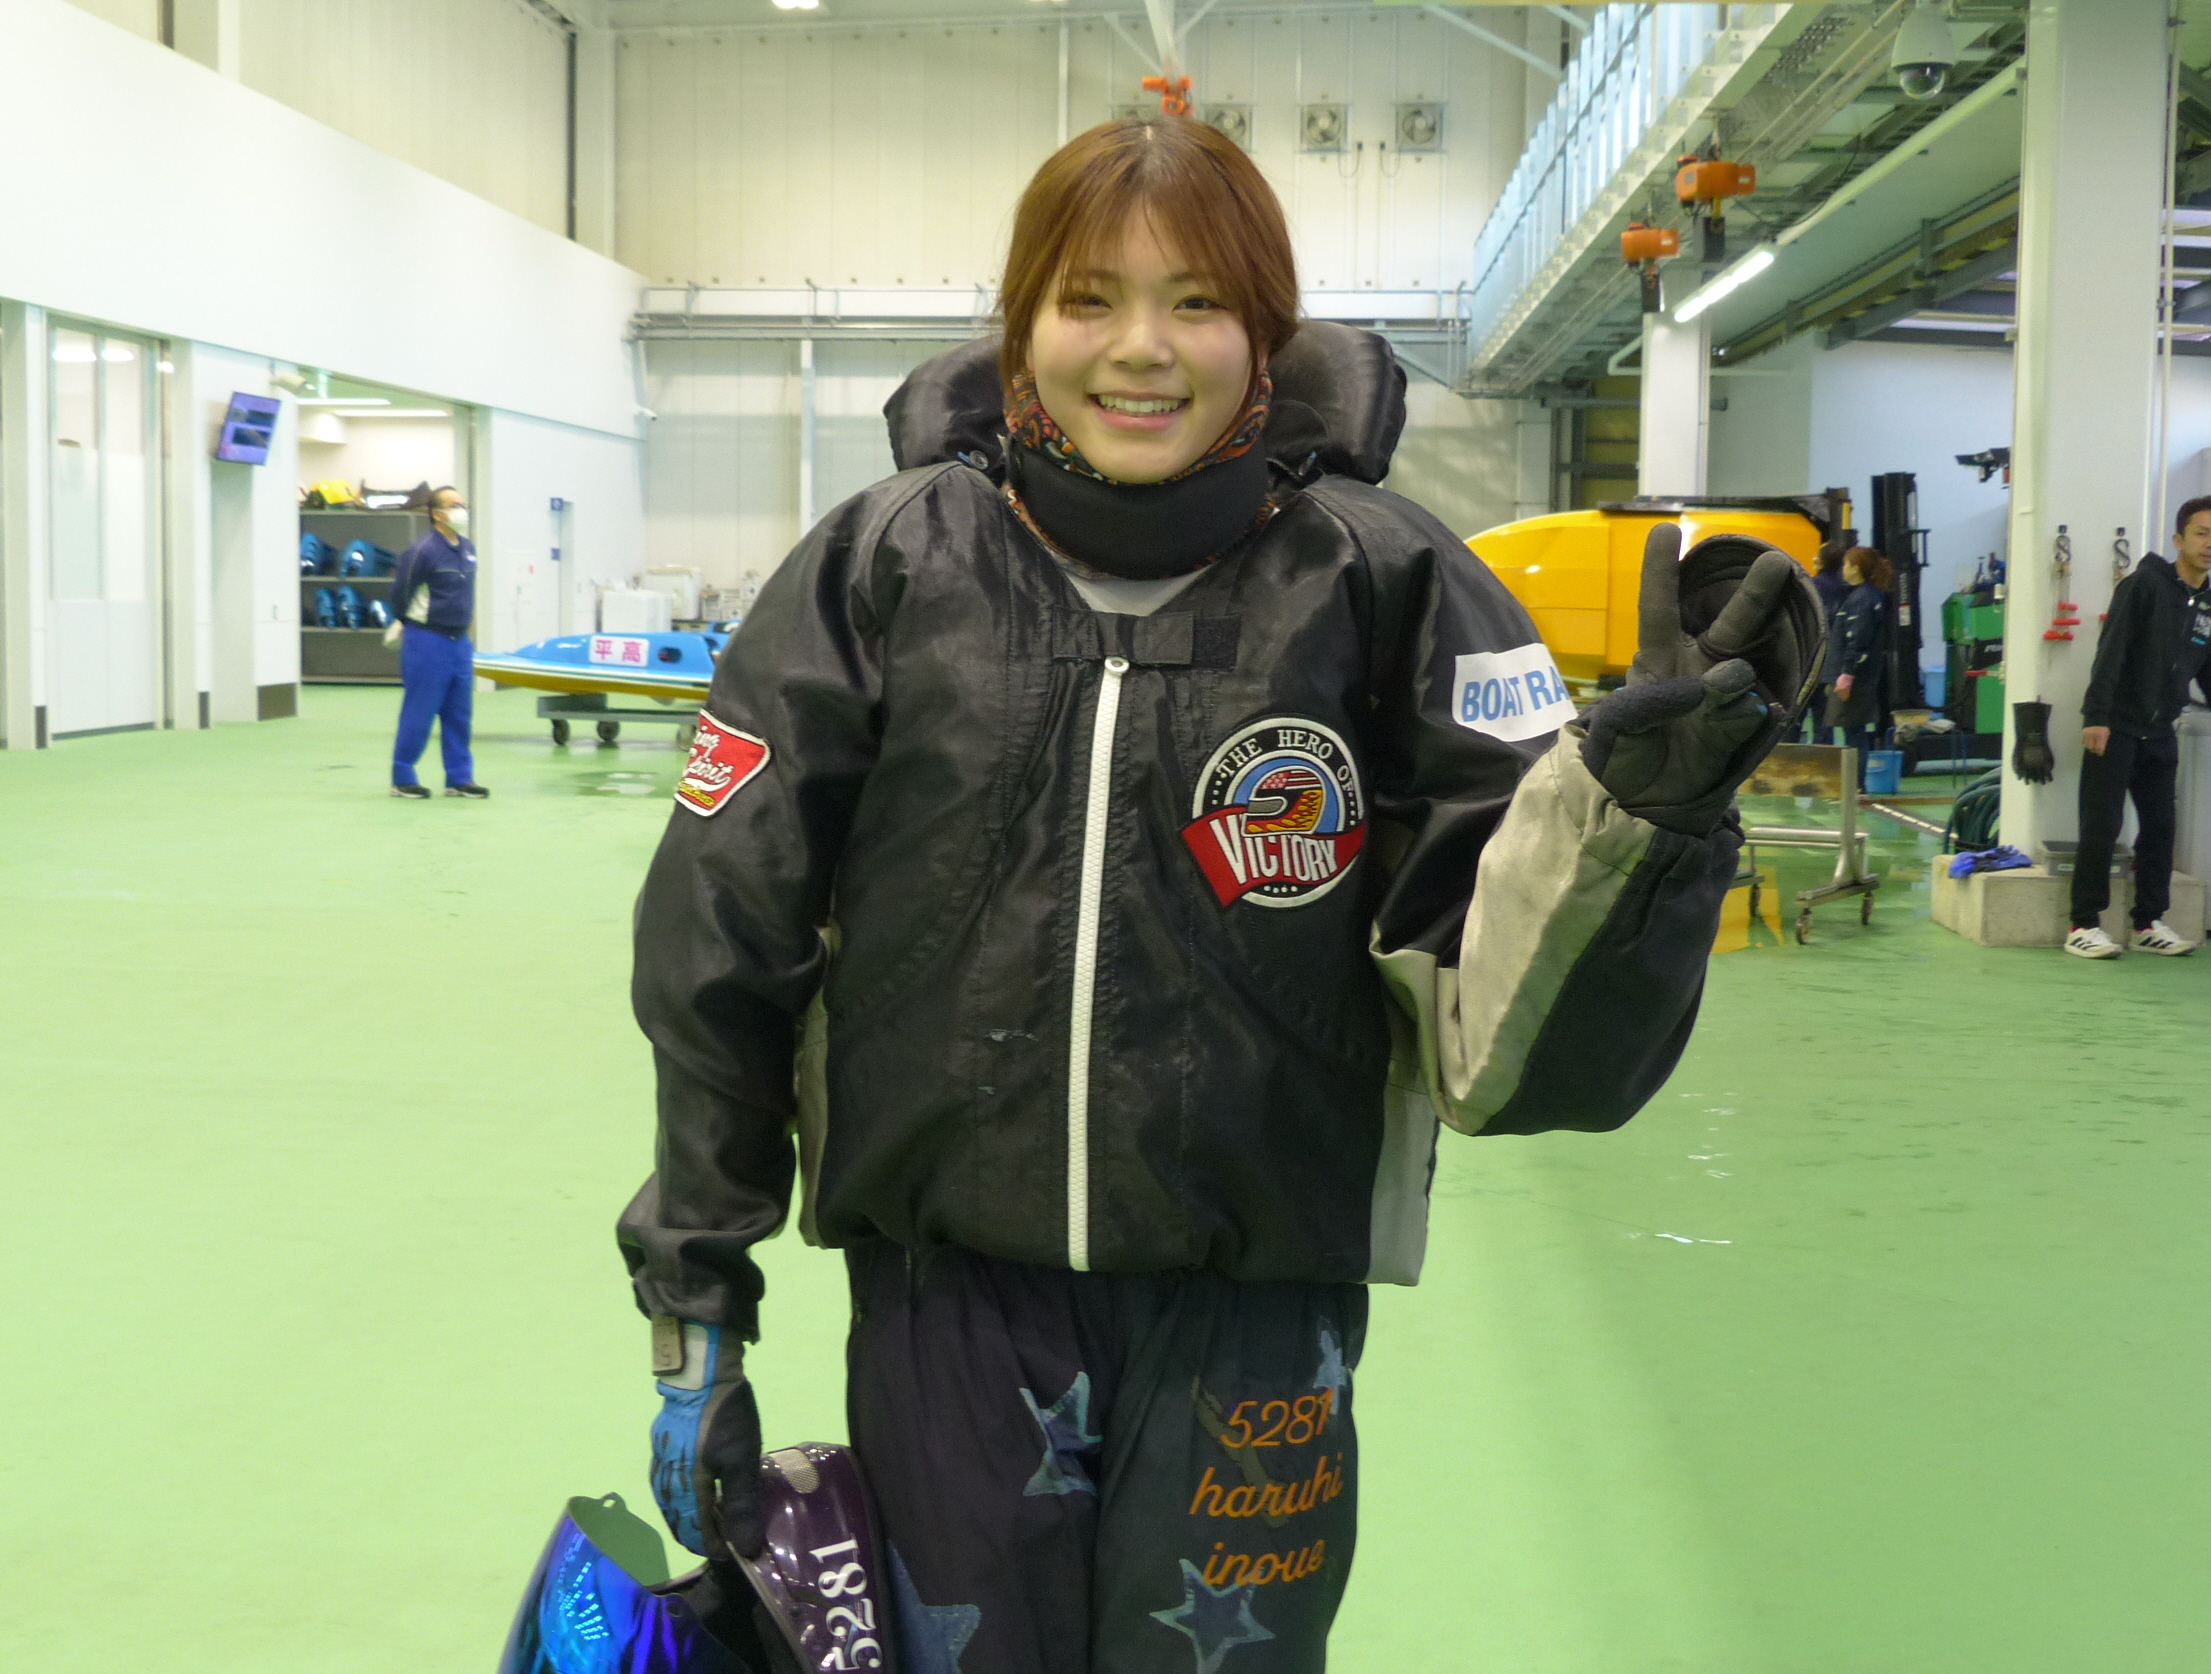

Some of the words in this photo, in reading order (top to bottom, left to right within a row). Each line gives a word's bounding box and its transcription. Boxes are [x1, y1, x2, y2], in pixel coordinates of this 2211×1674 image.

[1461, 676, 1524, 722] BOAT
[1215, 738, 1263, 777] THE
[1277, 729, 1334, 759] HERO
[1337, 765, 1354, 791] OF
[1209, 814, 1338, 885] VICTORY
[1220, 1388, 1335, 1448] 5281
[1189, 1452, 1345, 1518] haruhi
[1203, 1539, 1326, 1585] inoue
[808, 1533, 883, 1671] 5281
